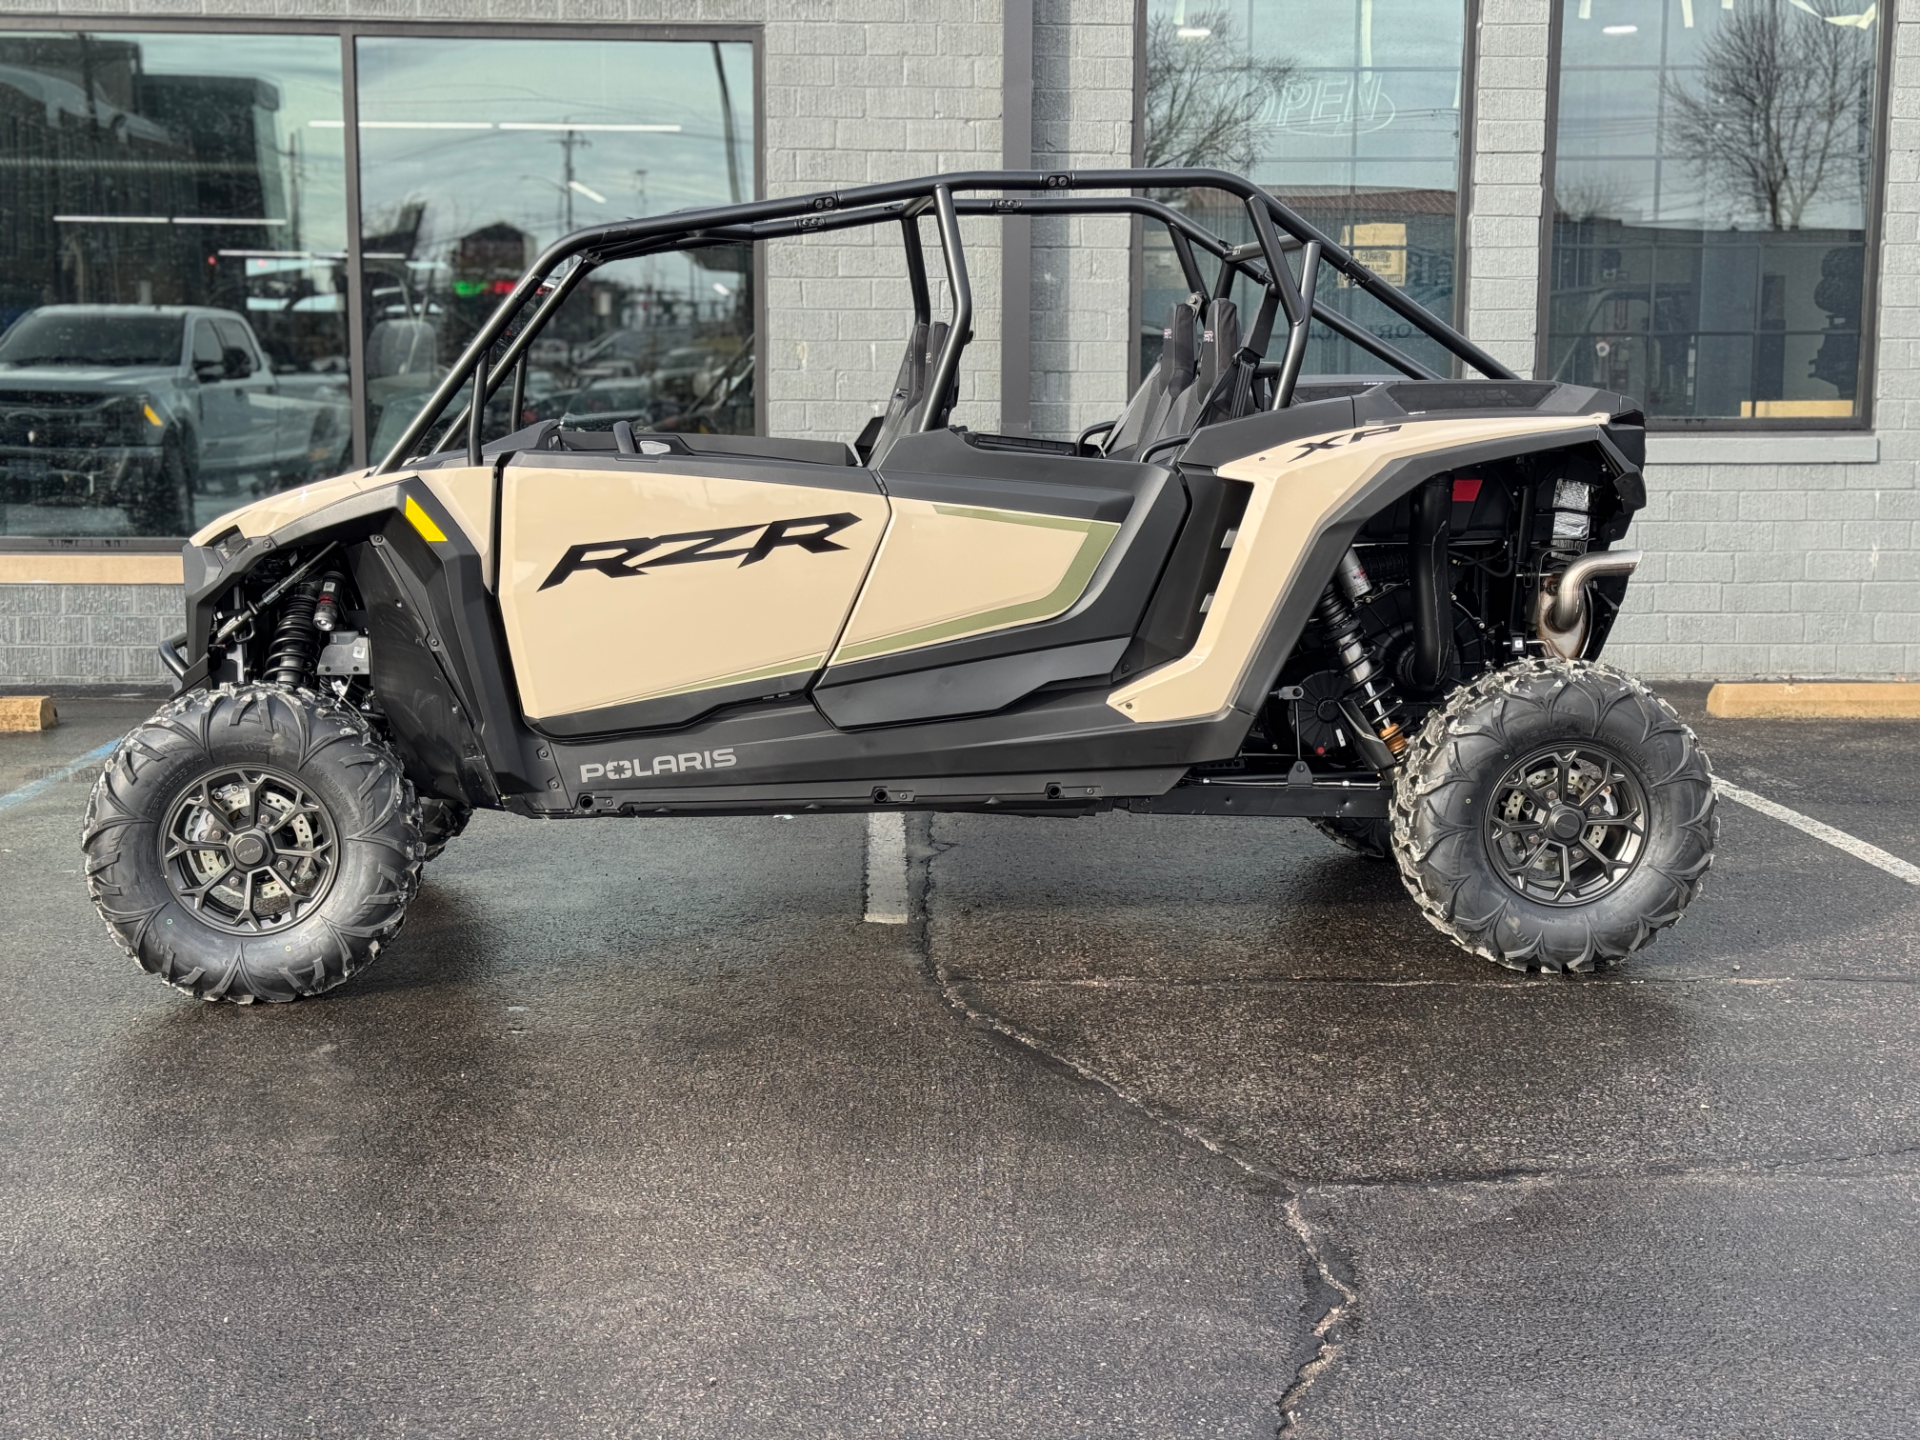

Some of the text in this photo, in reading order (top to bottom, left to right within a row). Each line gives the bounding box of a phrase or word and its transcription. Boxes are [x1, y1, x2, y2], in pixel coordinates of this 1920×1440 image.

[1243, 73, 1383, 127] OPEN
[1286, 425, 1402, 463] XP
[536, 511, 863, 593] RZR
[580, 747, 738, 784] POLARIS
